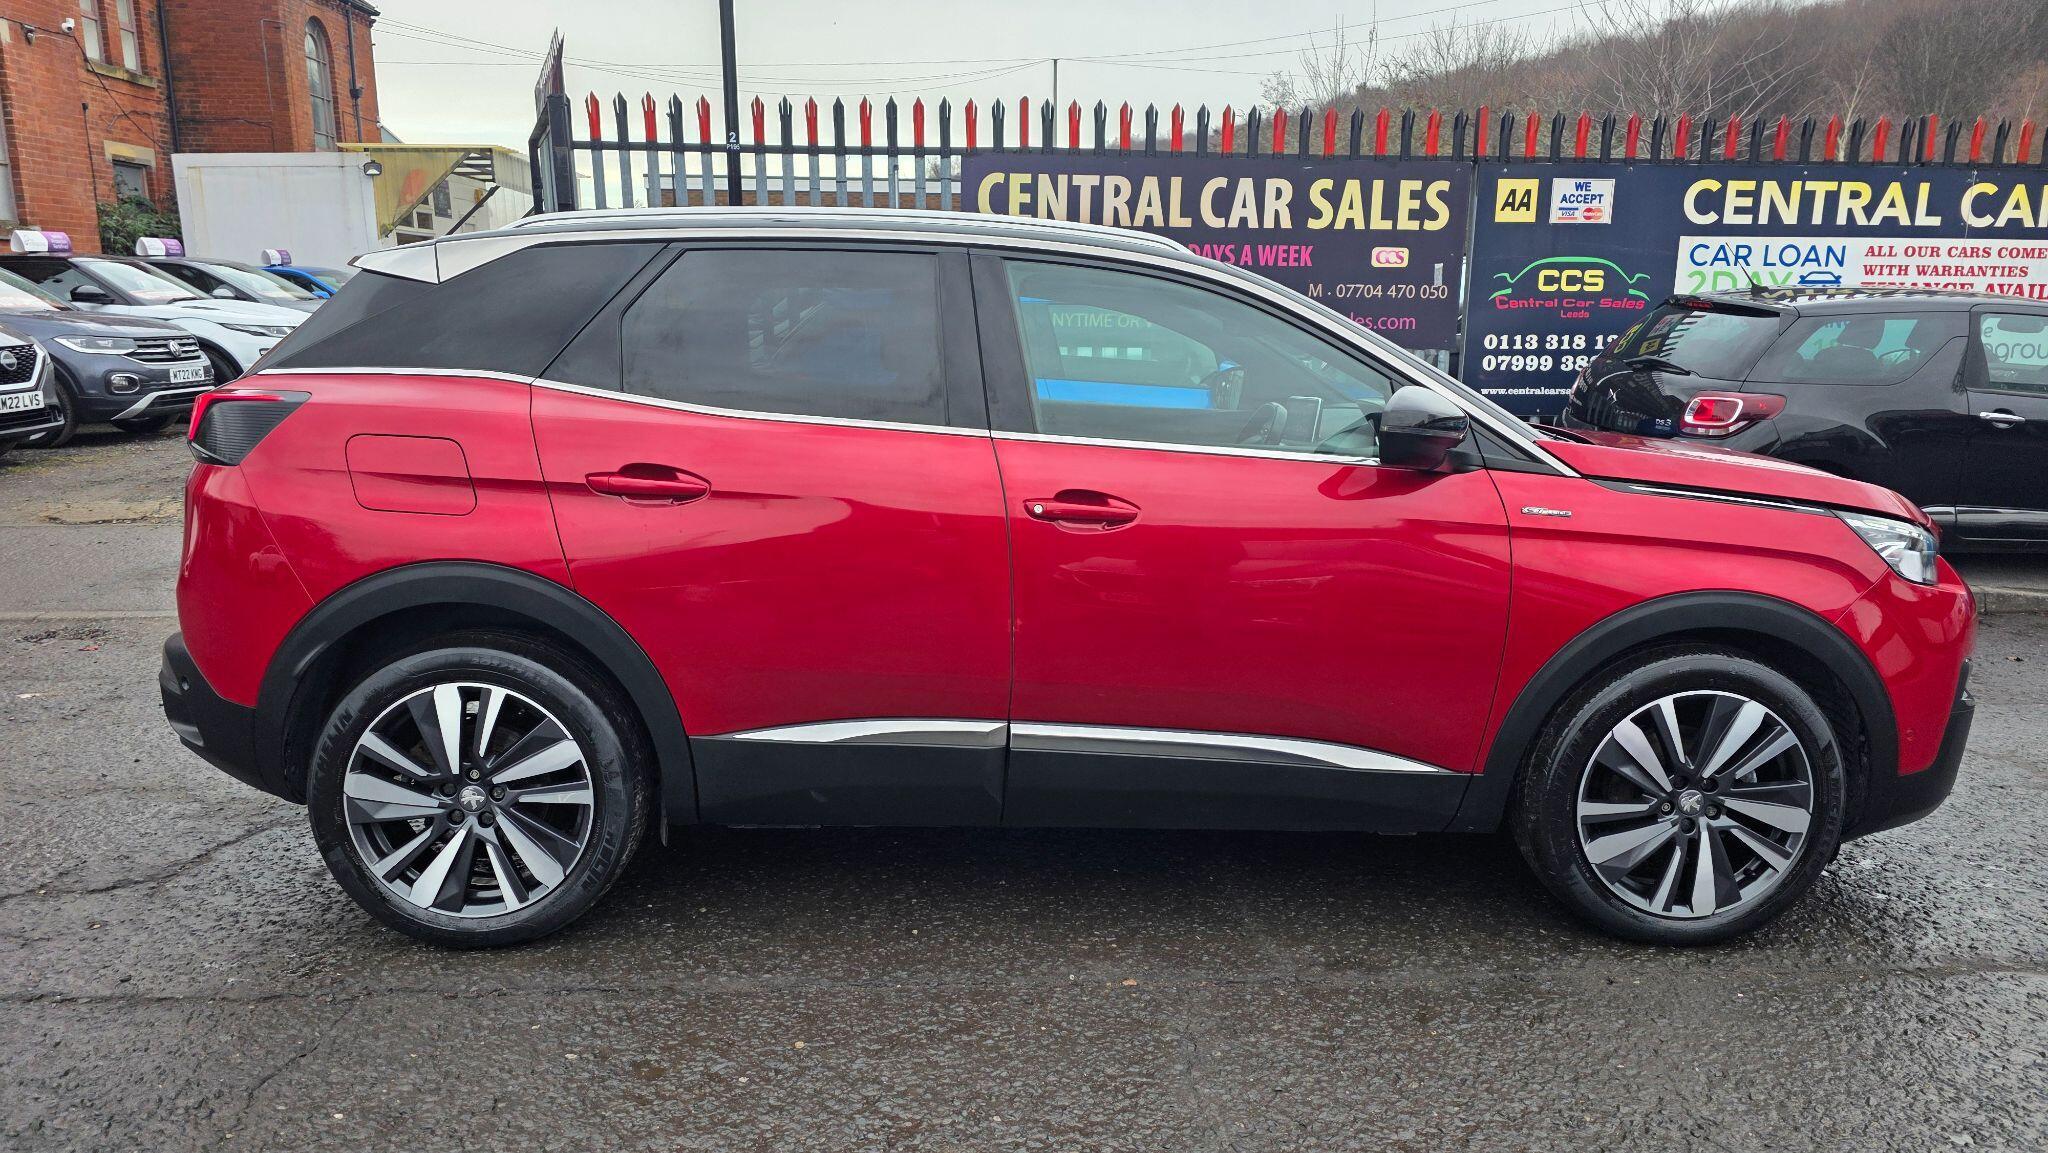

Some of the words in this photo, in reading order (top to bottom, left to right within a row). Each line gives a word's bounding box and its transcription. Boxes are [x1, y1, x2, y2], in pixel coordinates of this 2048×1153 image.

[1574, 181, 1592, 192] WE
[977, 172, 1193, 228] CENTRAL
[1200, 176, 1293, 230] CAR
[1307, 178, 1451, 231] SALES
[1500, 188, 1532, 212] AA
[1560, 193, 1604, 204] ACCEPT
[1683, 178, 1942, 227] CENTRAL
[1239, 244, 1253, 267] A
[1256, 244, 1314, 267] WEEK
[1689, 244, 1753, 267] CAR
[1763, 243, 1847, 268] LOAN
[1864, 245, 1898, 257] ALL
[1903, 246, 1942, 258] OUR
[1947, 246, 1992, 259] CARS
[1997, 247, 2048, 260] COME
[1863, 264, 1910, 276] WITH
[1915, 265, 2029, 278] WARRANTIES
[1538, 269, 1605, 292] CCS
[1688, 269, 1794, 296] 2DAY
[1308, 283, 1323, 298] M
[1336, 283, 1383, 299] 07704
[1387, 283, 1416, 299] 470
[1420, 284, 1448, 299] 050
[1495, 295, 1558, 310] Central
[1562, 298, 1595, 308] Car
[1599, 297, 1646, 310] Sales
[1560, 309, 1590, 318] Leeds
[1483, 333, 1539, 350] 0113
[1545, 333, 1587, 350] 318
[1482, 354, 1554, 372] 07999
[1560, 354, 1598, 372] 38
[0, 395, 21, 411] M22
[22, 393, 41, 408] LVS
